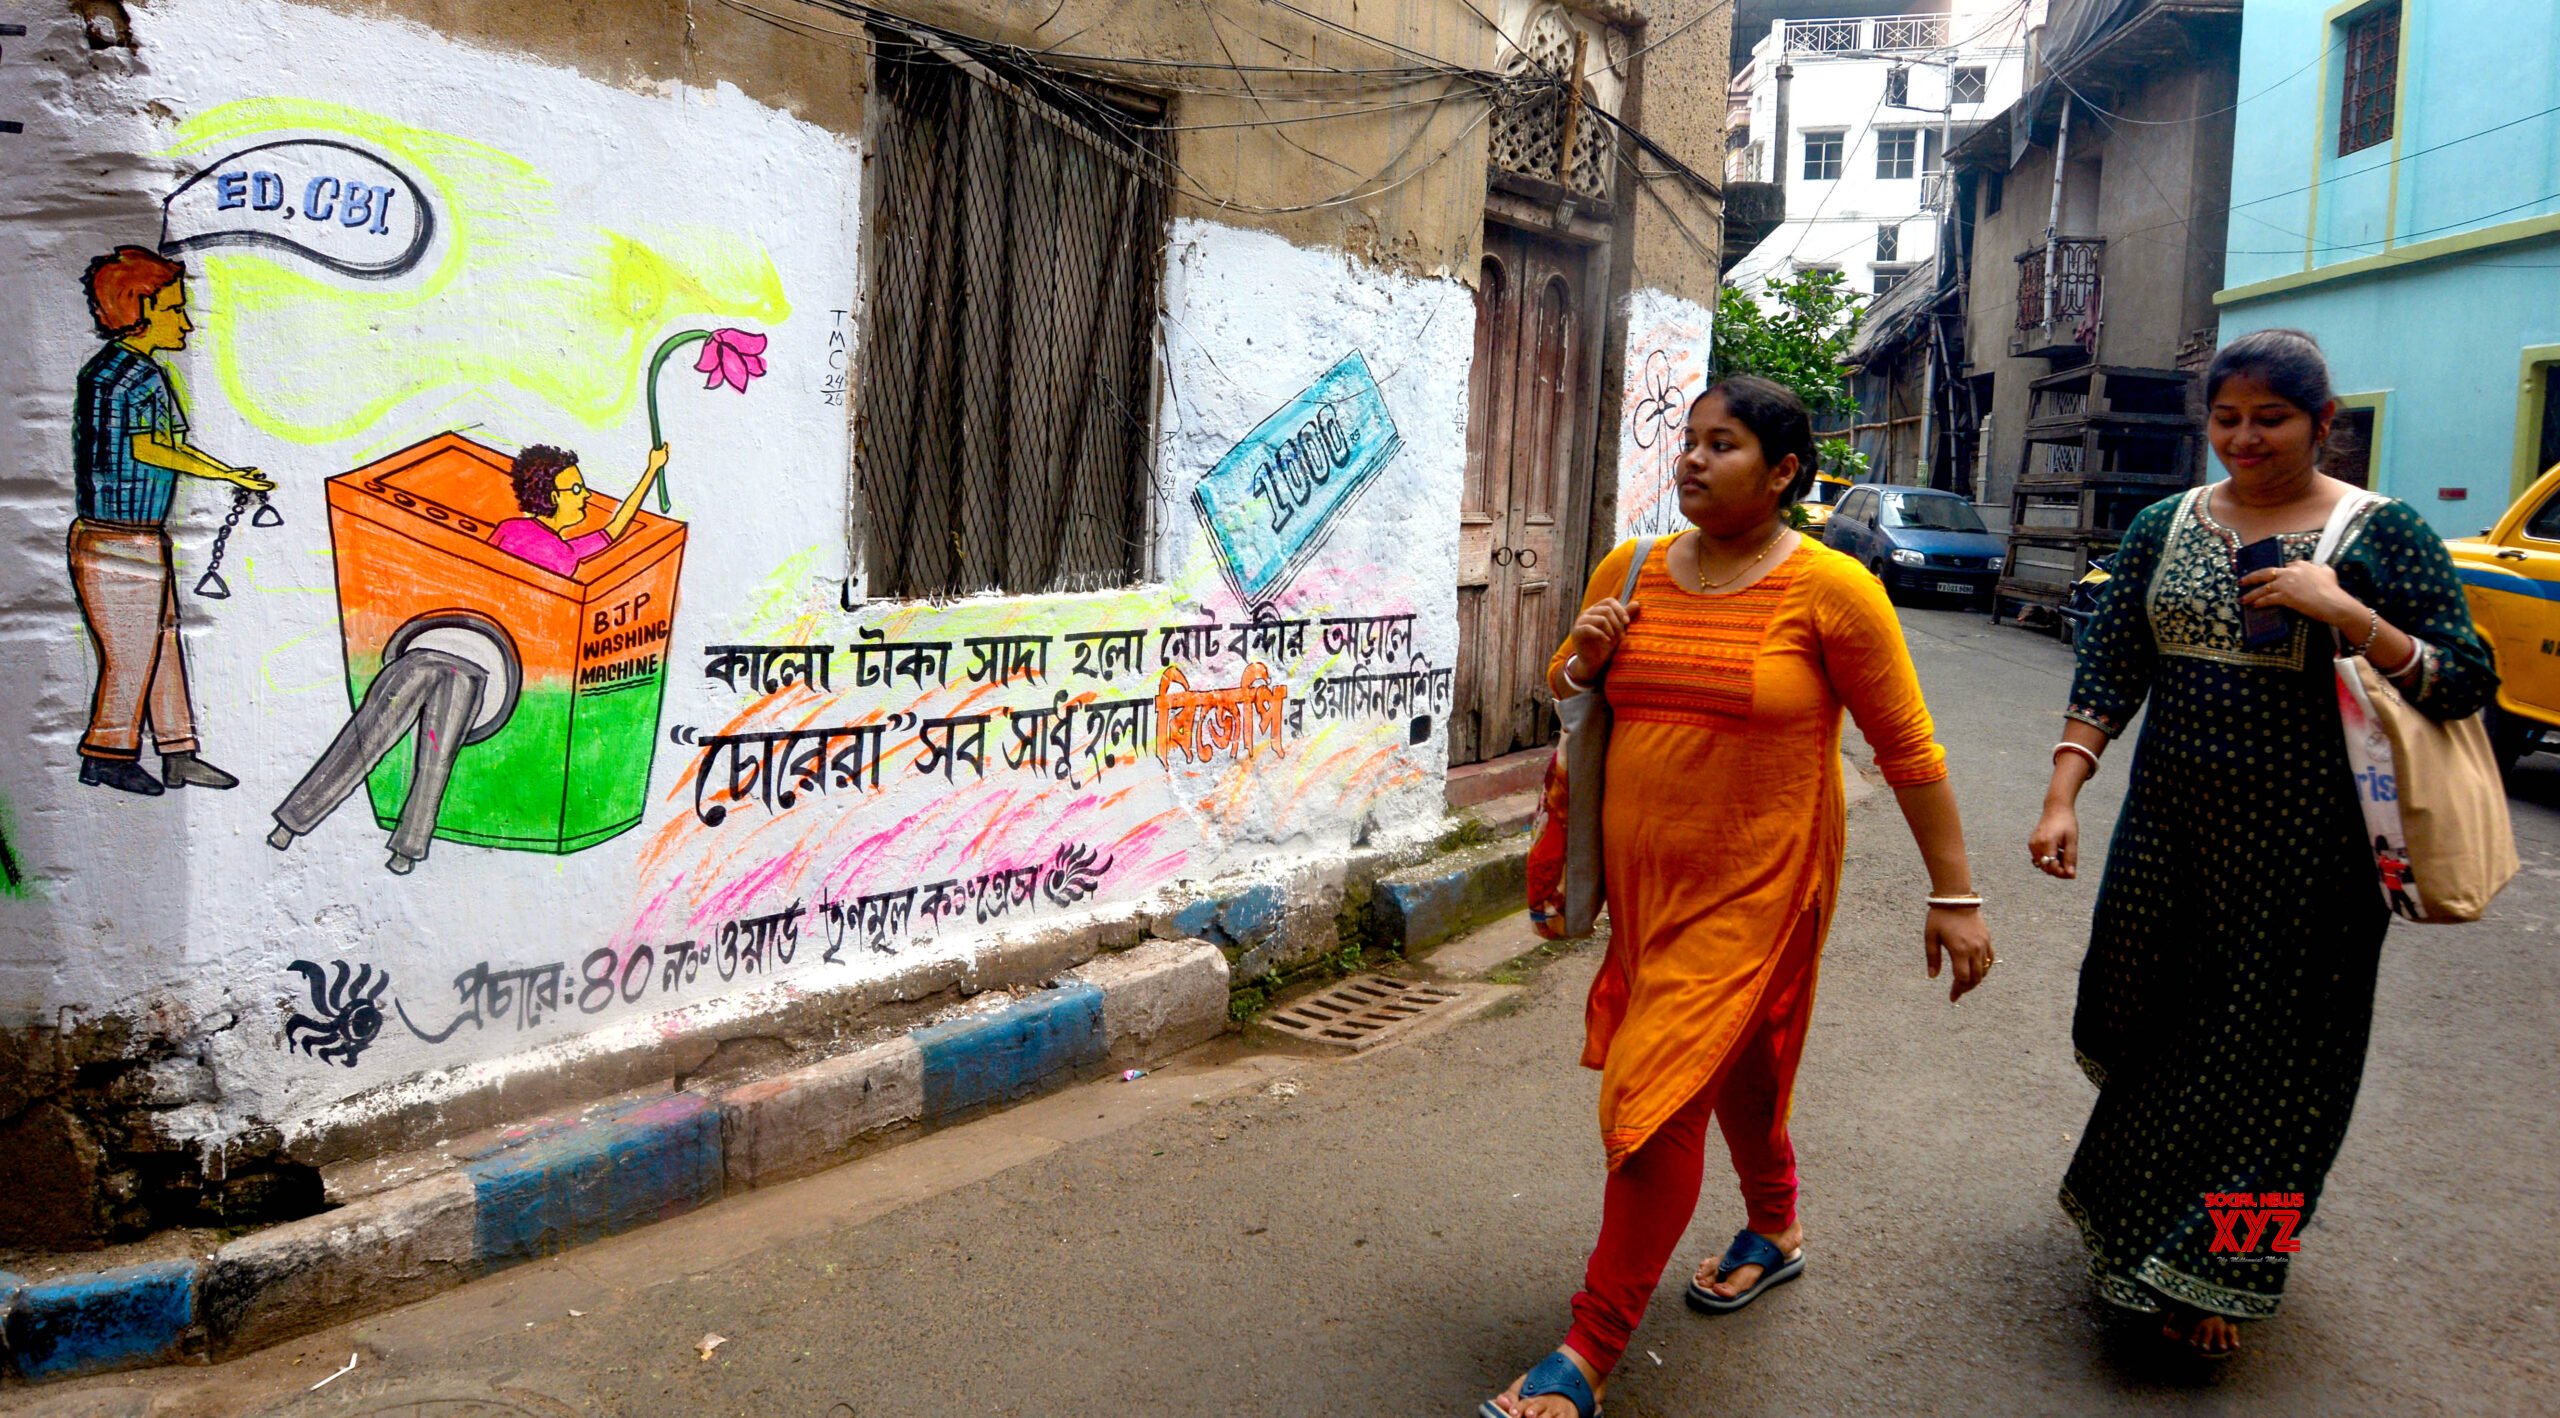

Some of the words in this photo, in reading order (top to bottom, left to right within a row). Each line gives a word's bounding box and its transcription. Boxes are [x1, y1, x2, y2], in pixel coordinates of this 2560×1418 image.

[302, 175, 396, 236] CBI
[828, 309, 848, 370] TMC
[1253, 403, 1350, 535] 1000
[583, 619, 668, 661] WASHING
[593, 592, 651, 635] BJP
[580, 653, 658, 684] MACHINE
[704, 645, 835, 696] কালো
[850, 625, 952, 692] টাকা
[964, 635, 1054, 687] সাদা
[1064, 628, 1148, 681] হলো
[1159, 603, 1223, 667] নোট
[914, 714, 992, 786] সব
[1084, 698, 1154, 784] হলো
